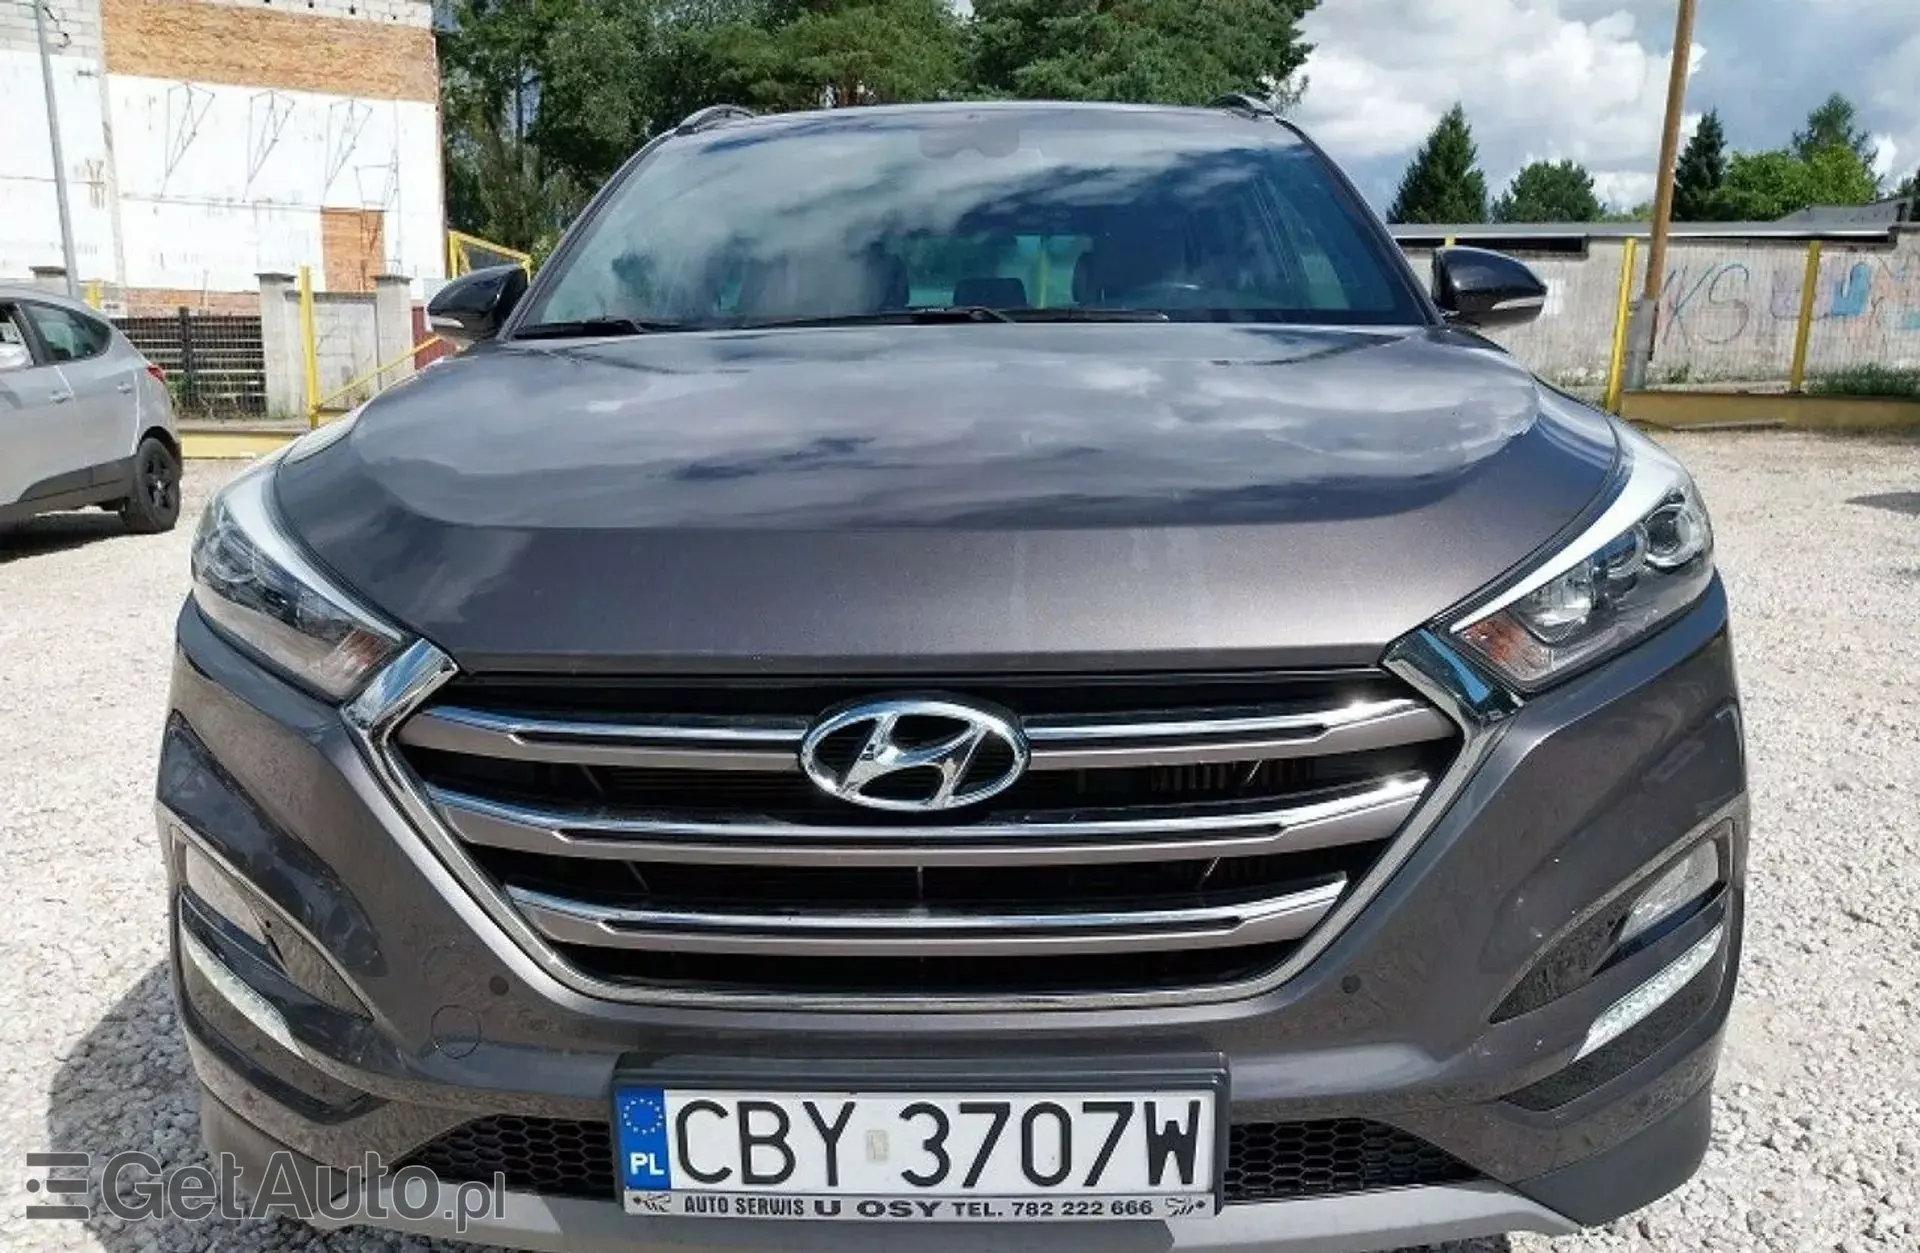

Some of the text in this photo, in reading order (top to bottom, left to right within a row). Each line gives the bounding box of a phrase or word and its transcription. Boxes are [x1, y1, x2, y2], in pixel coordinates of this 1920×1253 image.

[676, 1099, 1201, 1188] CBY 3707W
[630, 1152, 665, 1176] PL
[684, 1196, 1154, 1218] AUTO SERWIS U OSY TEL. 782 222 666
